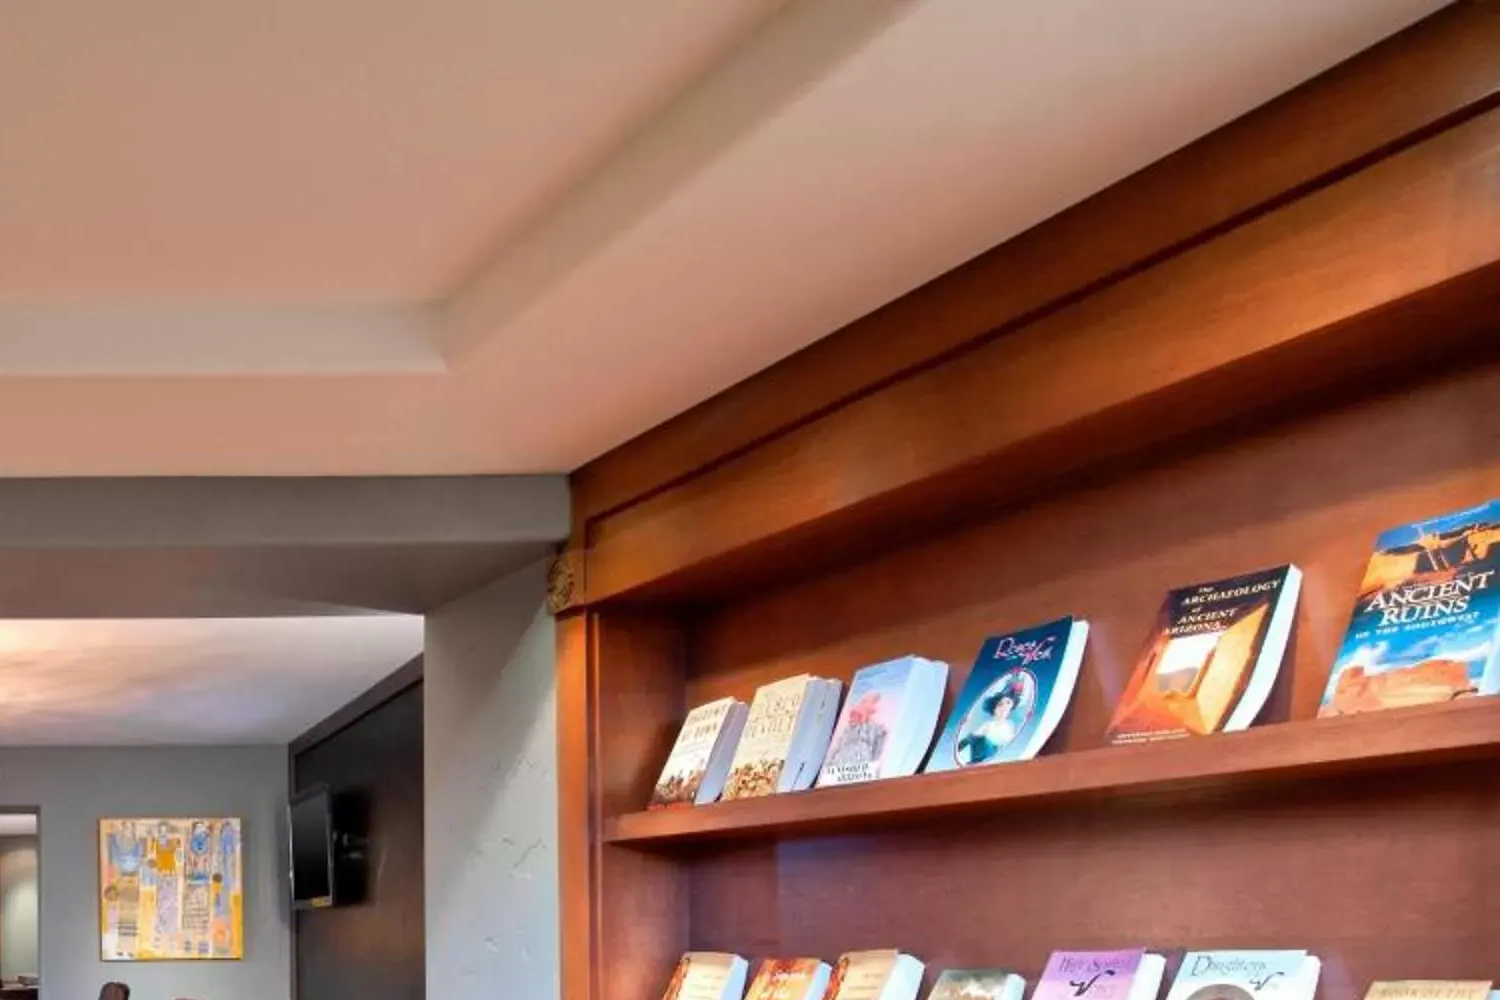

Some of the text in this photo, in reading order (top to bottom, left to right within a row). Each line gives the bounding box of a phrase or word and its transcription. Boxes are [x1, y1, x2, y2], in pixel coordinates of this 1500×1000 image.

[1182, 578, 1280, 605] ARCHAEOLOGY
[1364, 570, 1495, 613] ANCIENT
[1177, 607, 1239, 625] ANCIENT
[1378, 596, 1471, 627] RUINS
